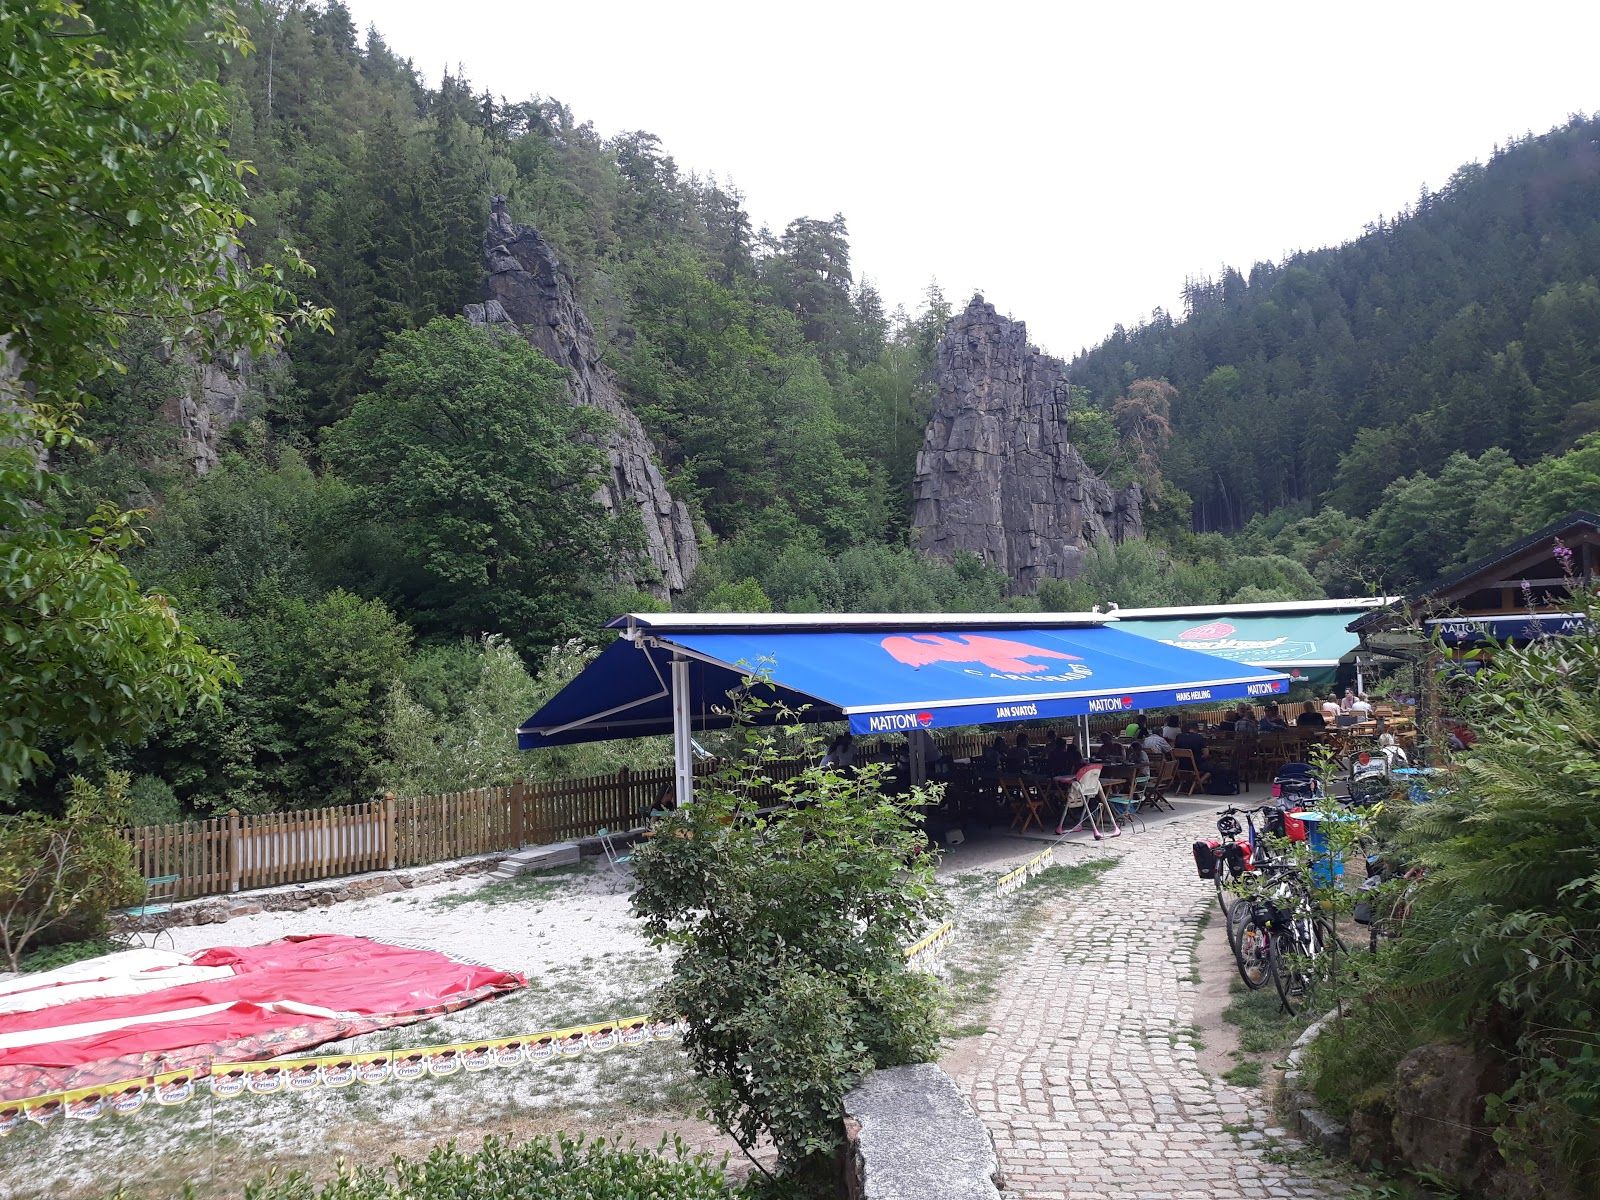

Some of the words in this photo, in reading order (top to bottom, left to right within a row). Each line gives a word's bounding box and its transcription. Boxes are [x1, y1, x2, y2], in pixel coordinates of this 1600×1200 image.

[1247, 683, 1273, 695] MATTONI
[1088, 698, 1122, 712] MATTONI
[996, 707, 1011, 718] JAN
[869, 713, 918, 732] MATTONI
